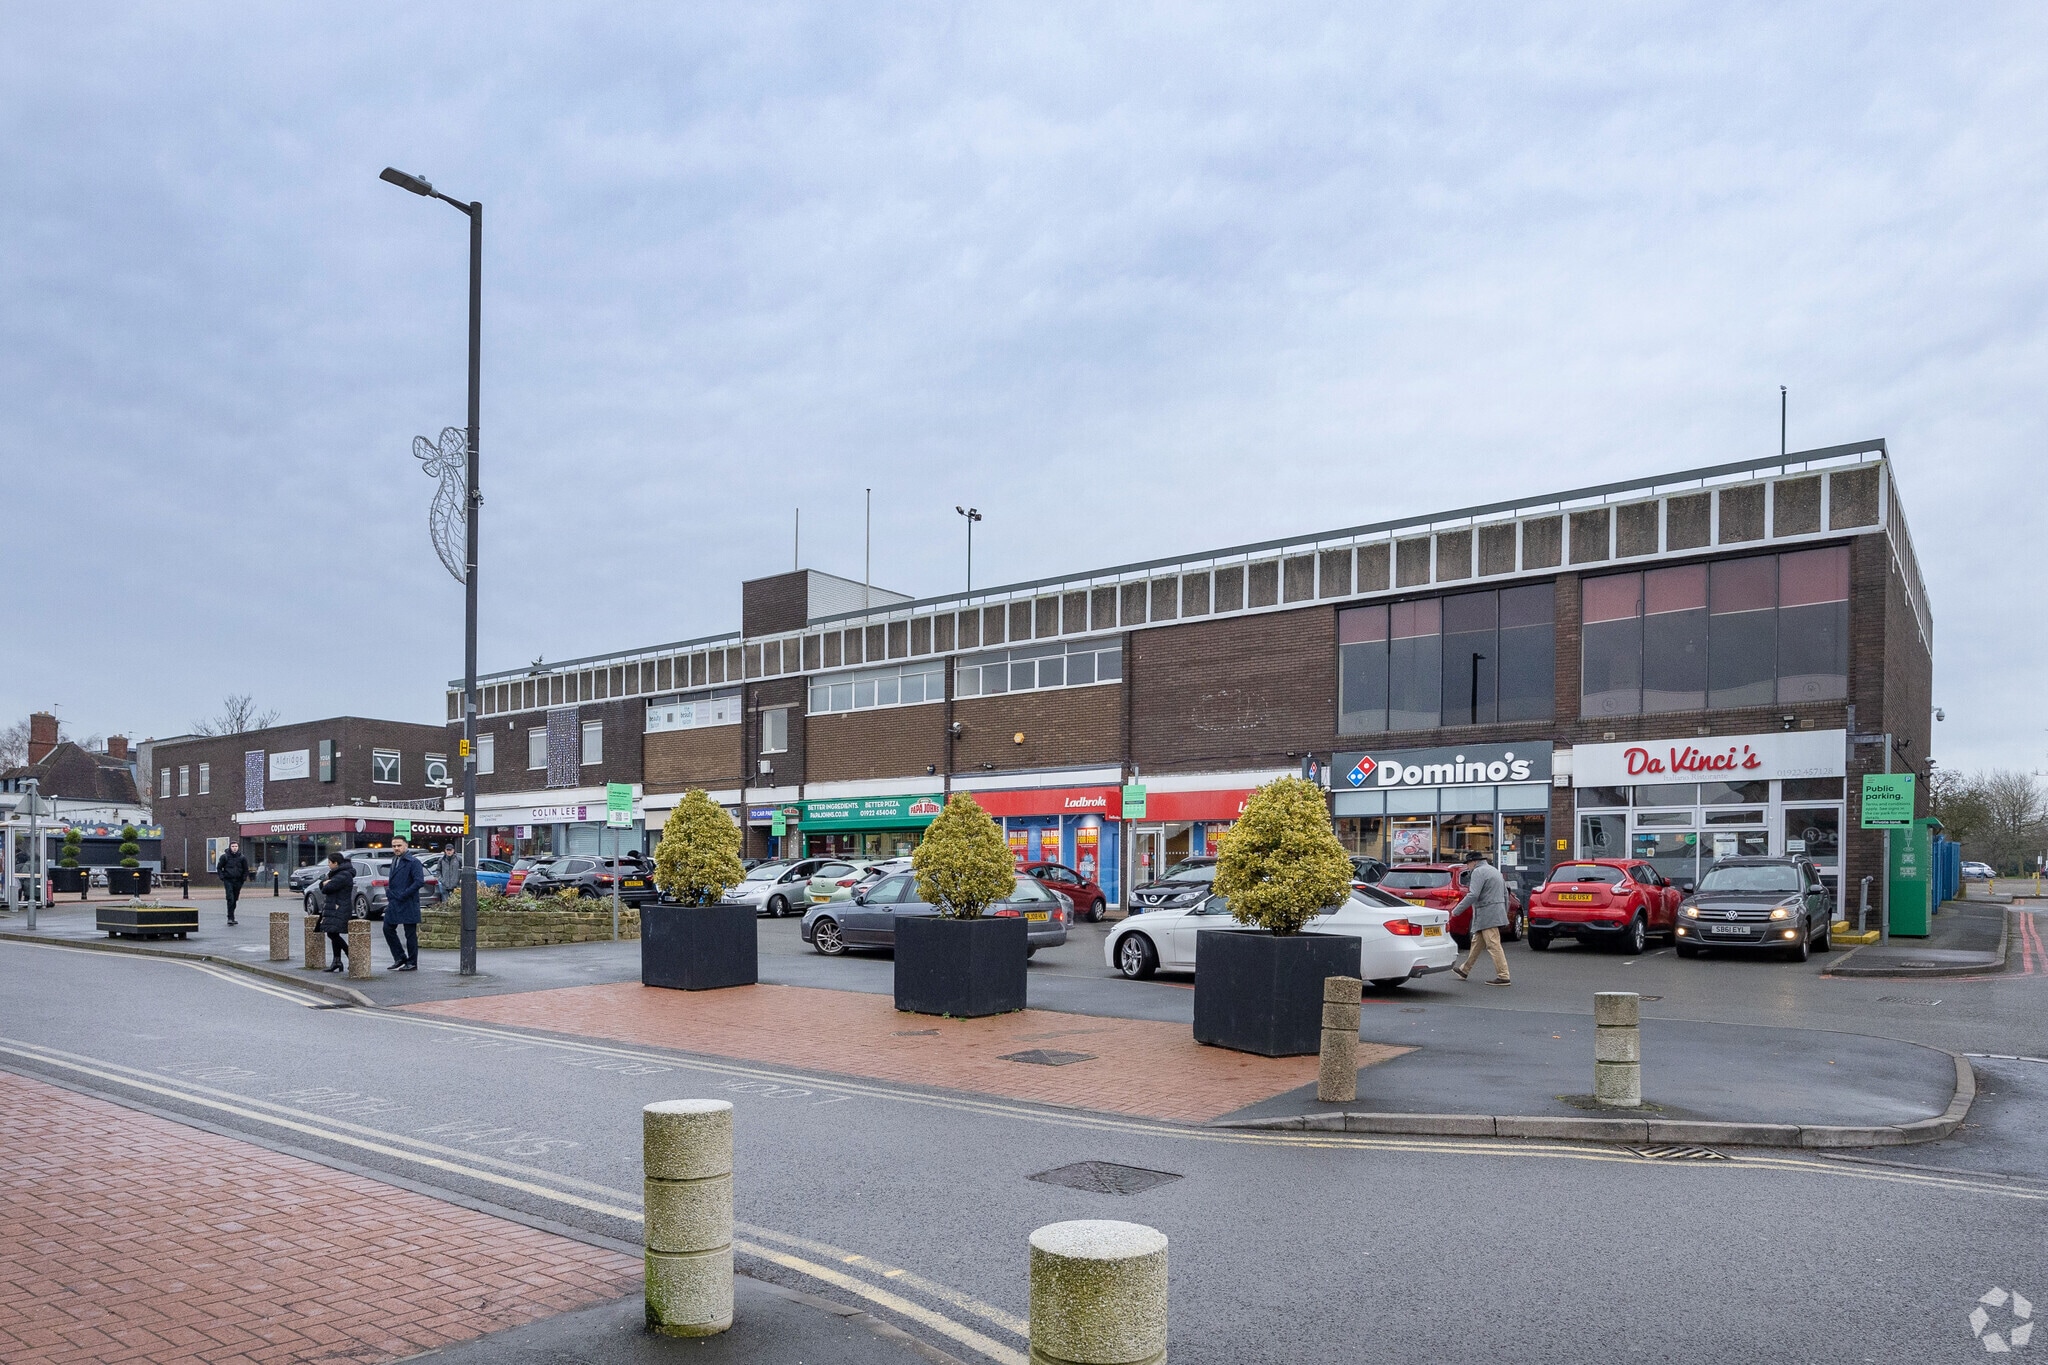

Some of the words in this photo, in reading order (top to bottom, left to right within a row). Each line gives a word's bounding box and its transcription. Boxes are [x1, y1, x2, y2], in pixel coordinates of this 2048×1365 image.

[276, 754, 303, 765] Aldridge
[1624, 747, 1665, 775] Da
[1670, 744, 1761, 773] Vinci's
[376, 757, 396, 780] Y
[1378, 752, 1531, 786] Domino's
[1777, 769, 1800, 777] 01922
[1803, 767, 1833, 775] 457128
[1064, 796, 1106, 808] Ladbroke
[532, 809, 557, 817] COLIN
[911, 804, 923, 814] PAPA
[271, 824, 285, 833] COSTA
[286, 823, 305, 831] COFFEE
[411, 824, 442, 833] COSTA
[445, 826, 464, 834] COF
